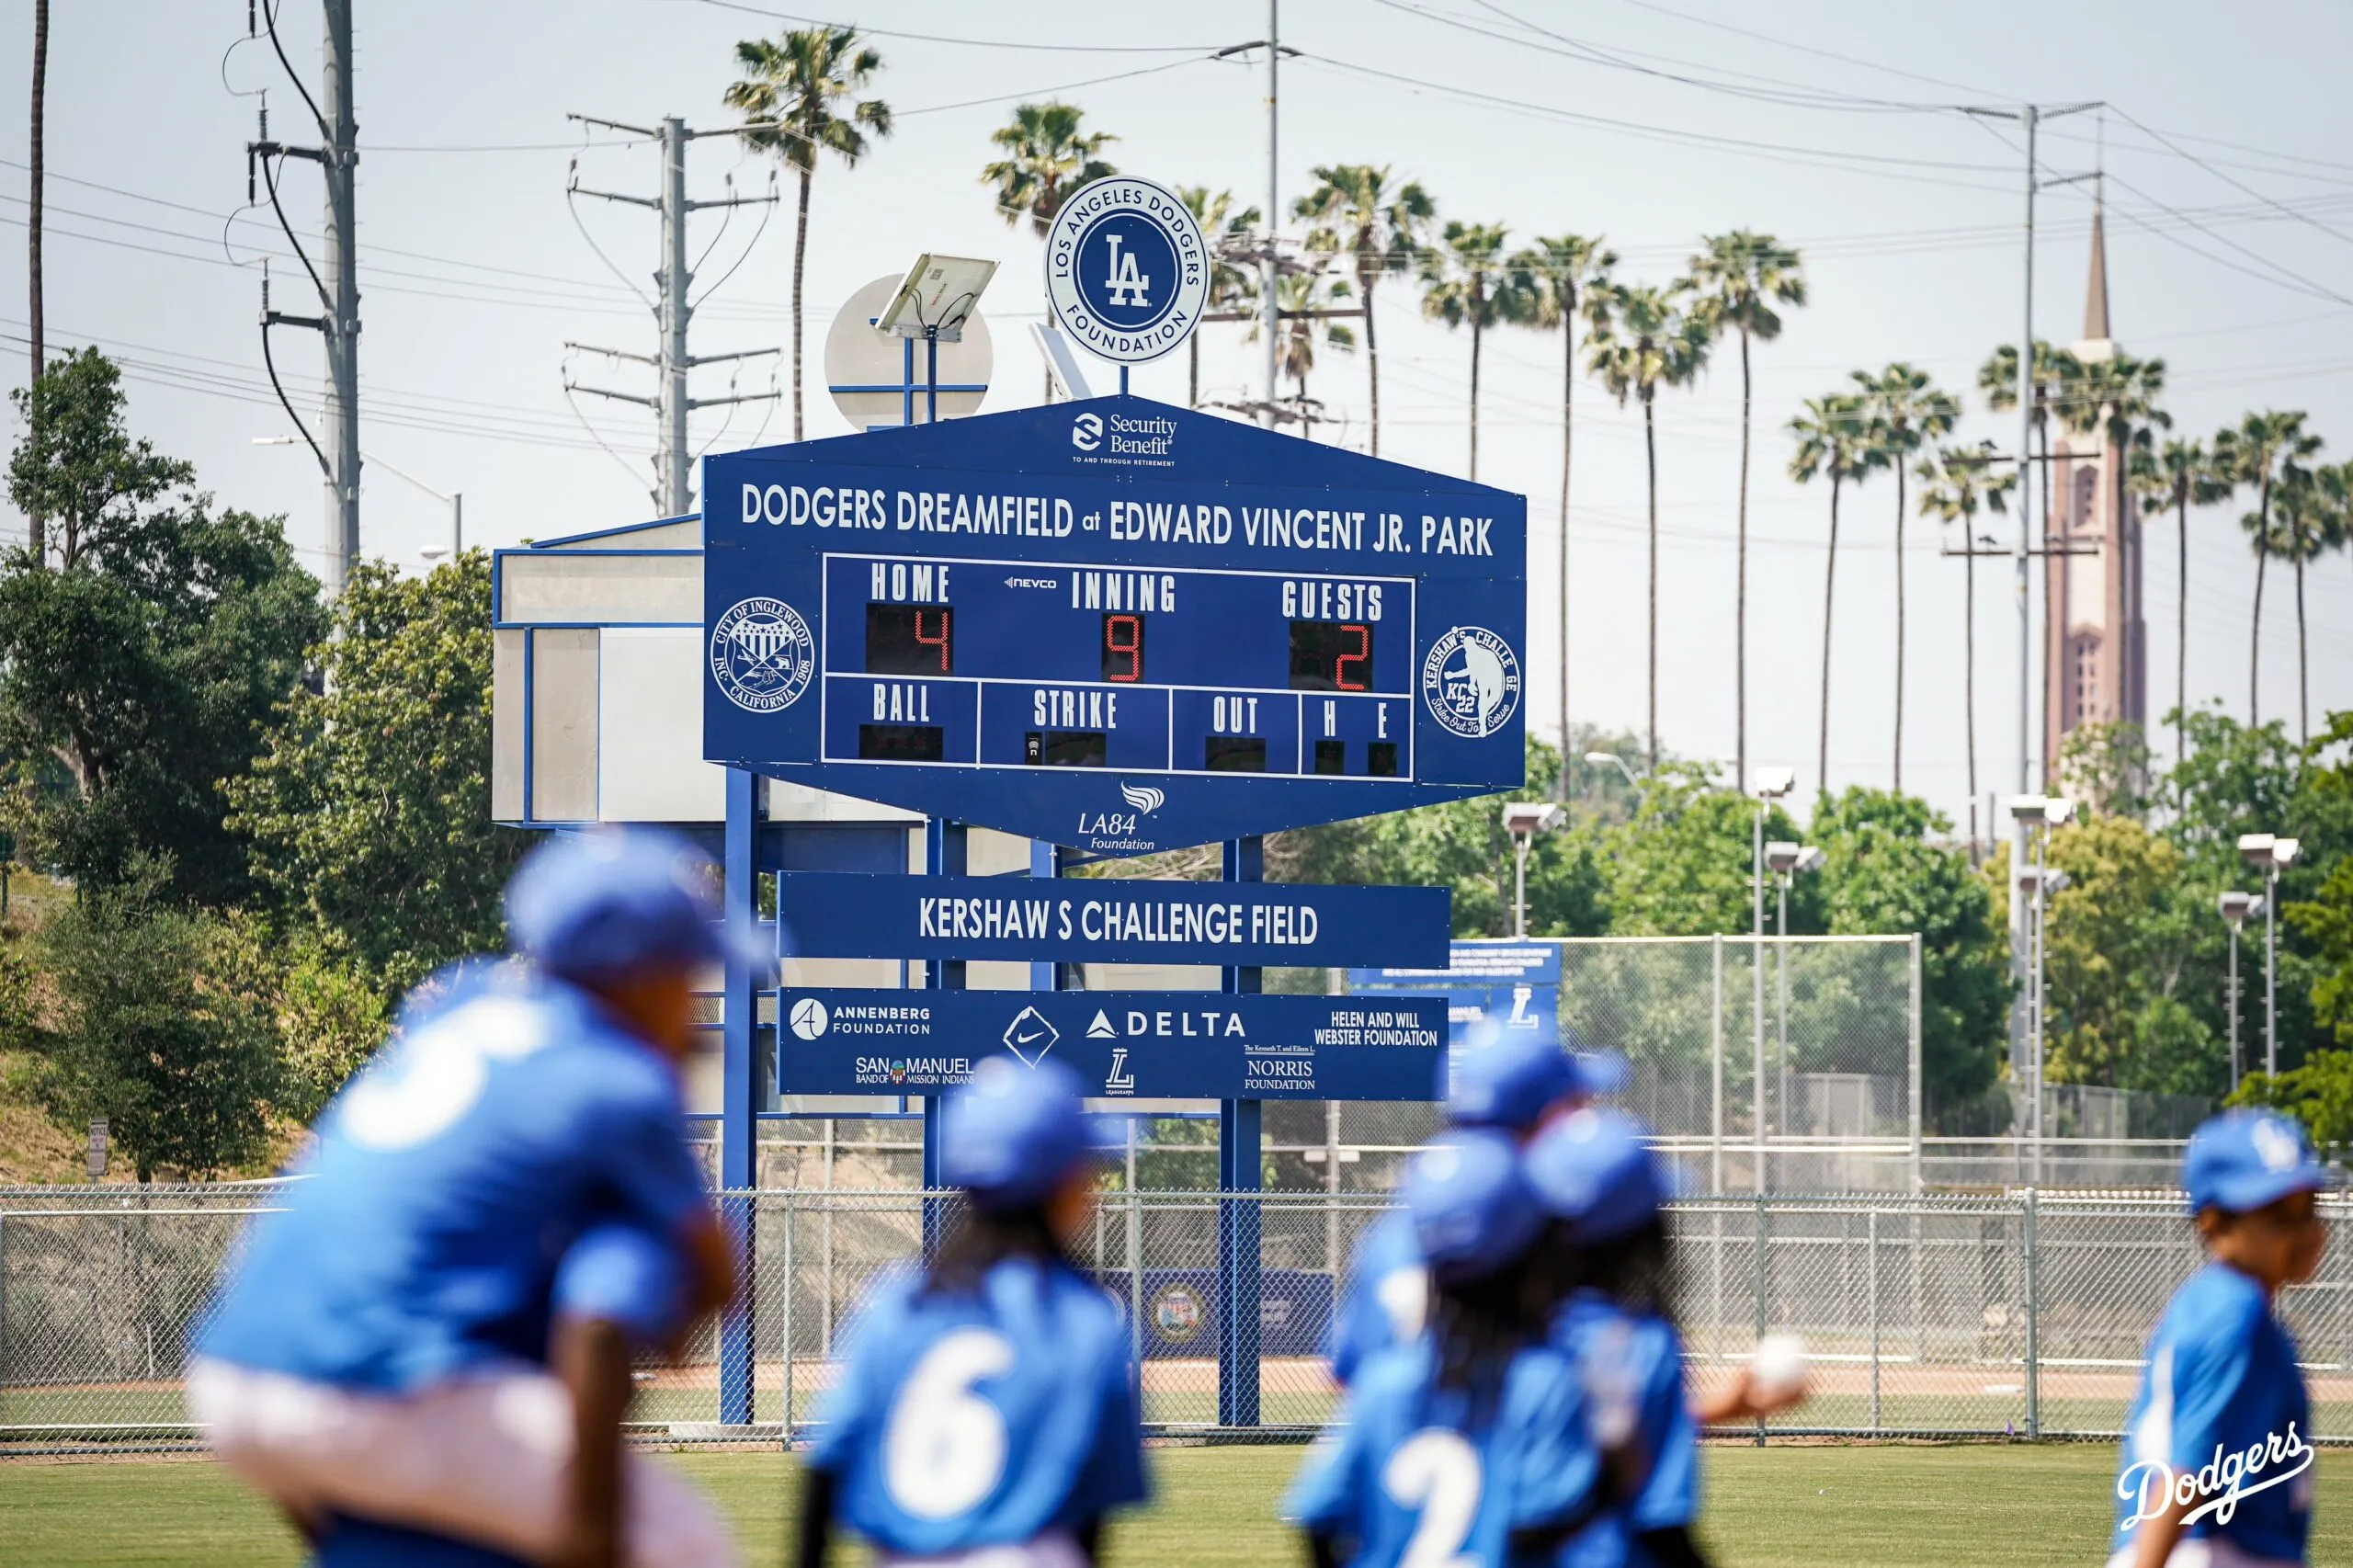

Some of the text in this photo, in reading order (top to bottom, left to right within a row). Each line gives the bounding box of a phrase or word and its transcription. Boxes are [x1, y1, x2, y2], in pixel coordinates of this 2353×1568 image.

[1056, 188, 1199, 286] LOS ANGELES DODGERS
[1105, 233, 1150, 307] LA
[1066, 303, 1188, 352] FOUNDATION
[1110, 414, 1177, 438] Security
[742, 483, 1494, 556] DODGERS DREAMFIELD at EDWARD VINCENT JR. PARK
[871, 562, 949, 603] HOME
[1072, 571, 1176, 613] INNING
[1282, 580, 1382, 621] GUESTS
[715, 601, 810, 647] CITY OF INGLEWOOD
[915, 610, 949, 671] 4
[1107, 615, 1140, 682] 9
[1336, 624, 1369, 690] 2
[795, 659, 811, 686] 1908
[729, 686, 797, 709] CALIFORNIA
[873, 683, 930, 722] BALL
[1034, 688, 1117, 729] STRIKE
[1445, 682, 1468, 701] KC
[1455, 696, 1475, 713] 22
[1213, 696, 1257, 733] OUT
[1324, 699, 1336, 737] H
[1378, 702, 1387, 739] E
[1431, 698, 1510, 733] Strike Out To Serve
[1078, 812, 1136, 835] LA84
[1090, 837, 1154, 850] Foundation
[919, 897, 1051, 939] KERSHAW
[1081, 900, 1243, 944] CHALLENGE
[1252, 903, 1318, 945] FIELD
[833, 1006, 930, 1020] ANNENBERG
[833, 1023, 930, 1035] FOUNDATION
[1128, 1011, 1246, 1038] DELTA
[1331, 1011, 1420, 1028] HELEN AND WILL
[1314, 1028, 1438, 1046] WEBSTER FOUNDATION
[856, 1057, 974, 1074] SAN MANUEL
[856, 1074, 974, 1085] BAND OF MISSION INDIANS
[1247, 1060, 1313, 1077] NORRIS
[1245, 1079, 1315, 1090] FOUNDATION
[884, 1325, 1013, 1521] 6
